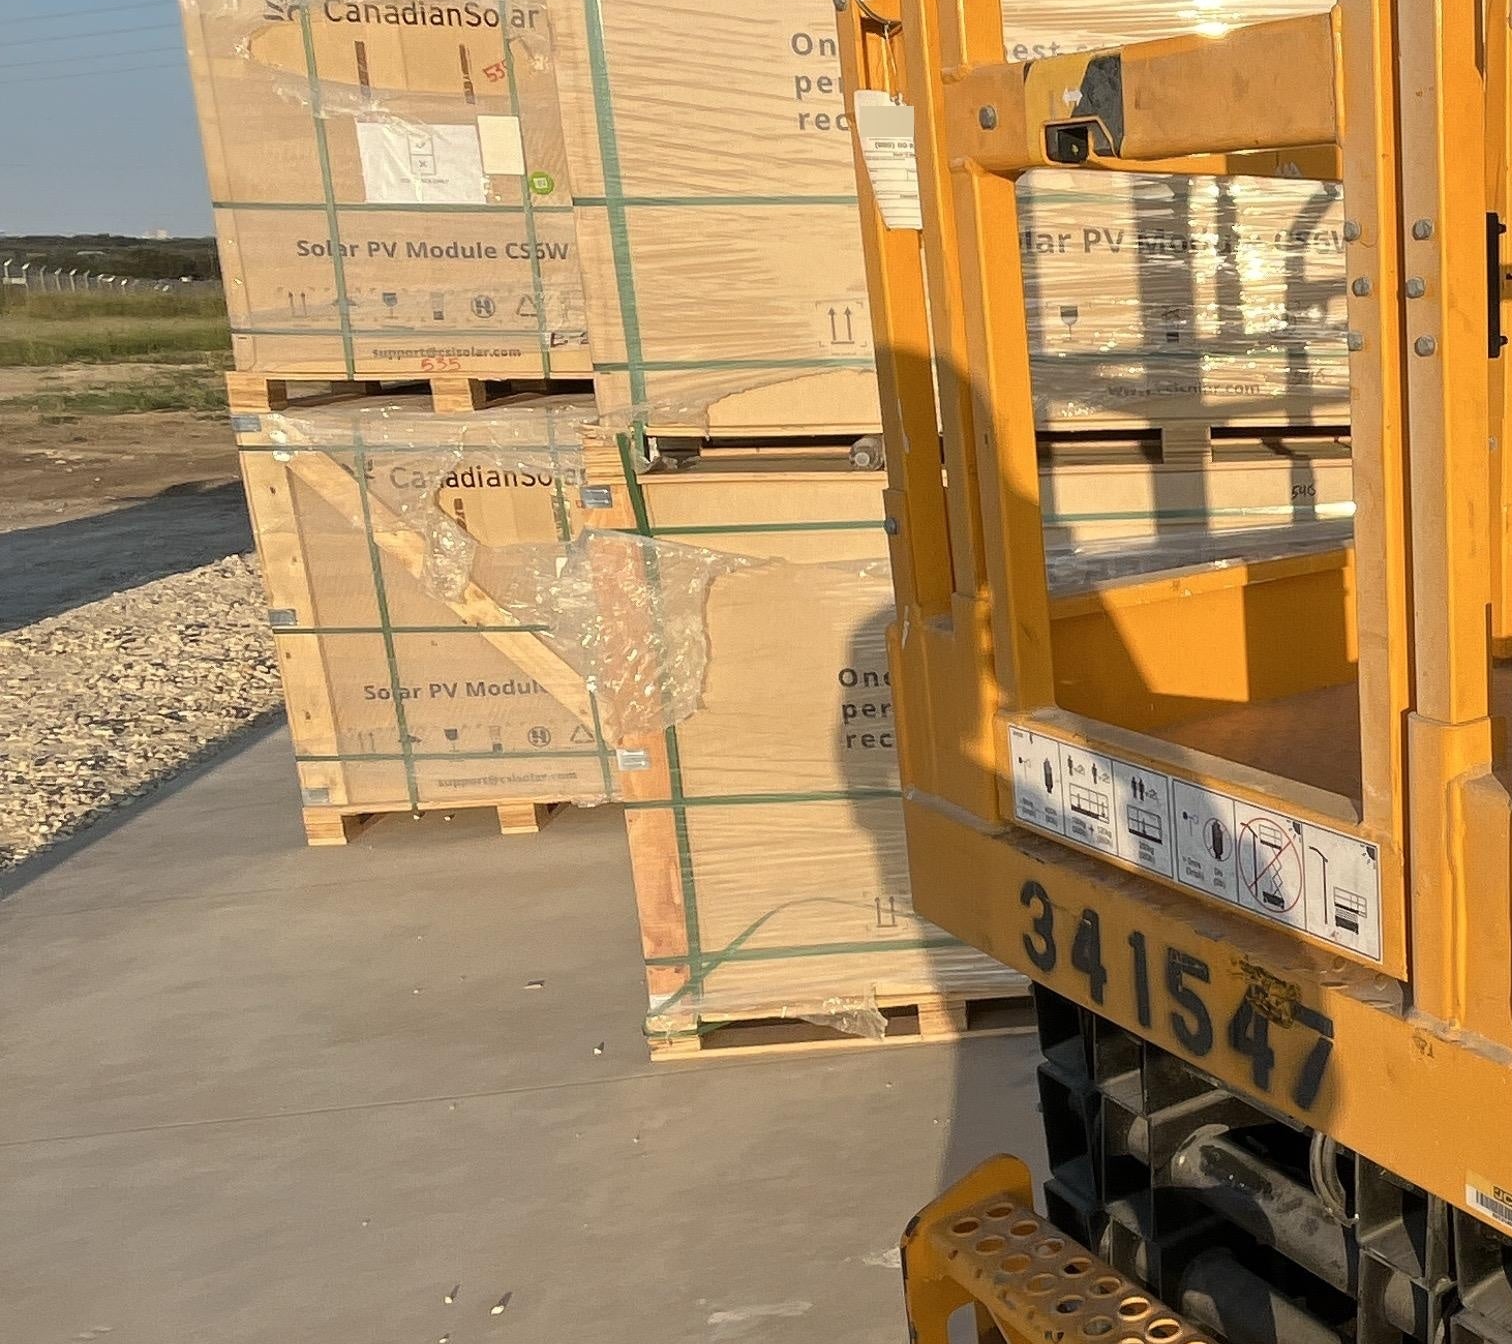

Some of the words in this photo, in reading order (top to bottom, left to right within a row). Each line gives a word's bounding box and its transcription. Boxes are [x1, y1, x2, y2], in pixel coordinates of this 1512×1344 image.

[367, 241, 398, 257] PV
[406, 241, 497, 259] Module
[1083, 228, 1124, 254] PV
[420, 357, 462, 372] 535
[364, 682, 422, 701] Soar
[430, 682, 458, 699] PV
[1019, 879, 1335, 1111] 341547
